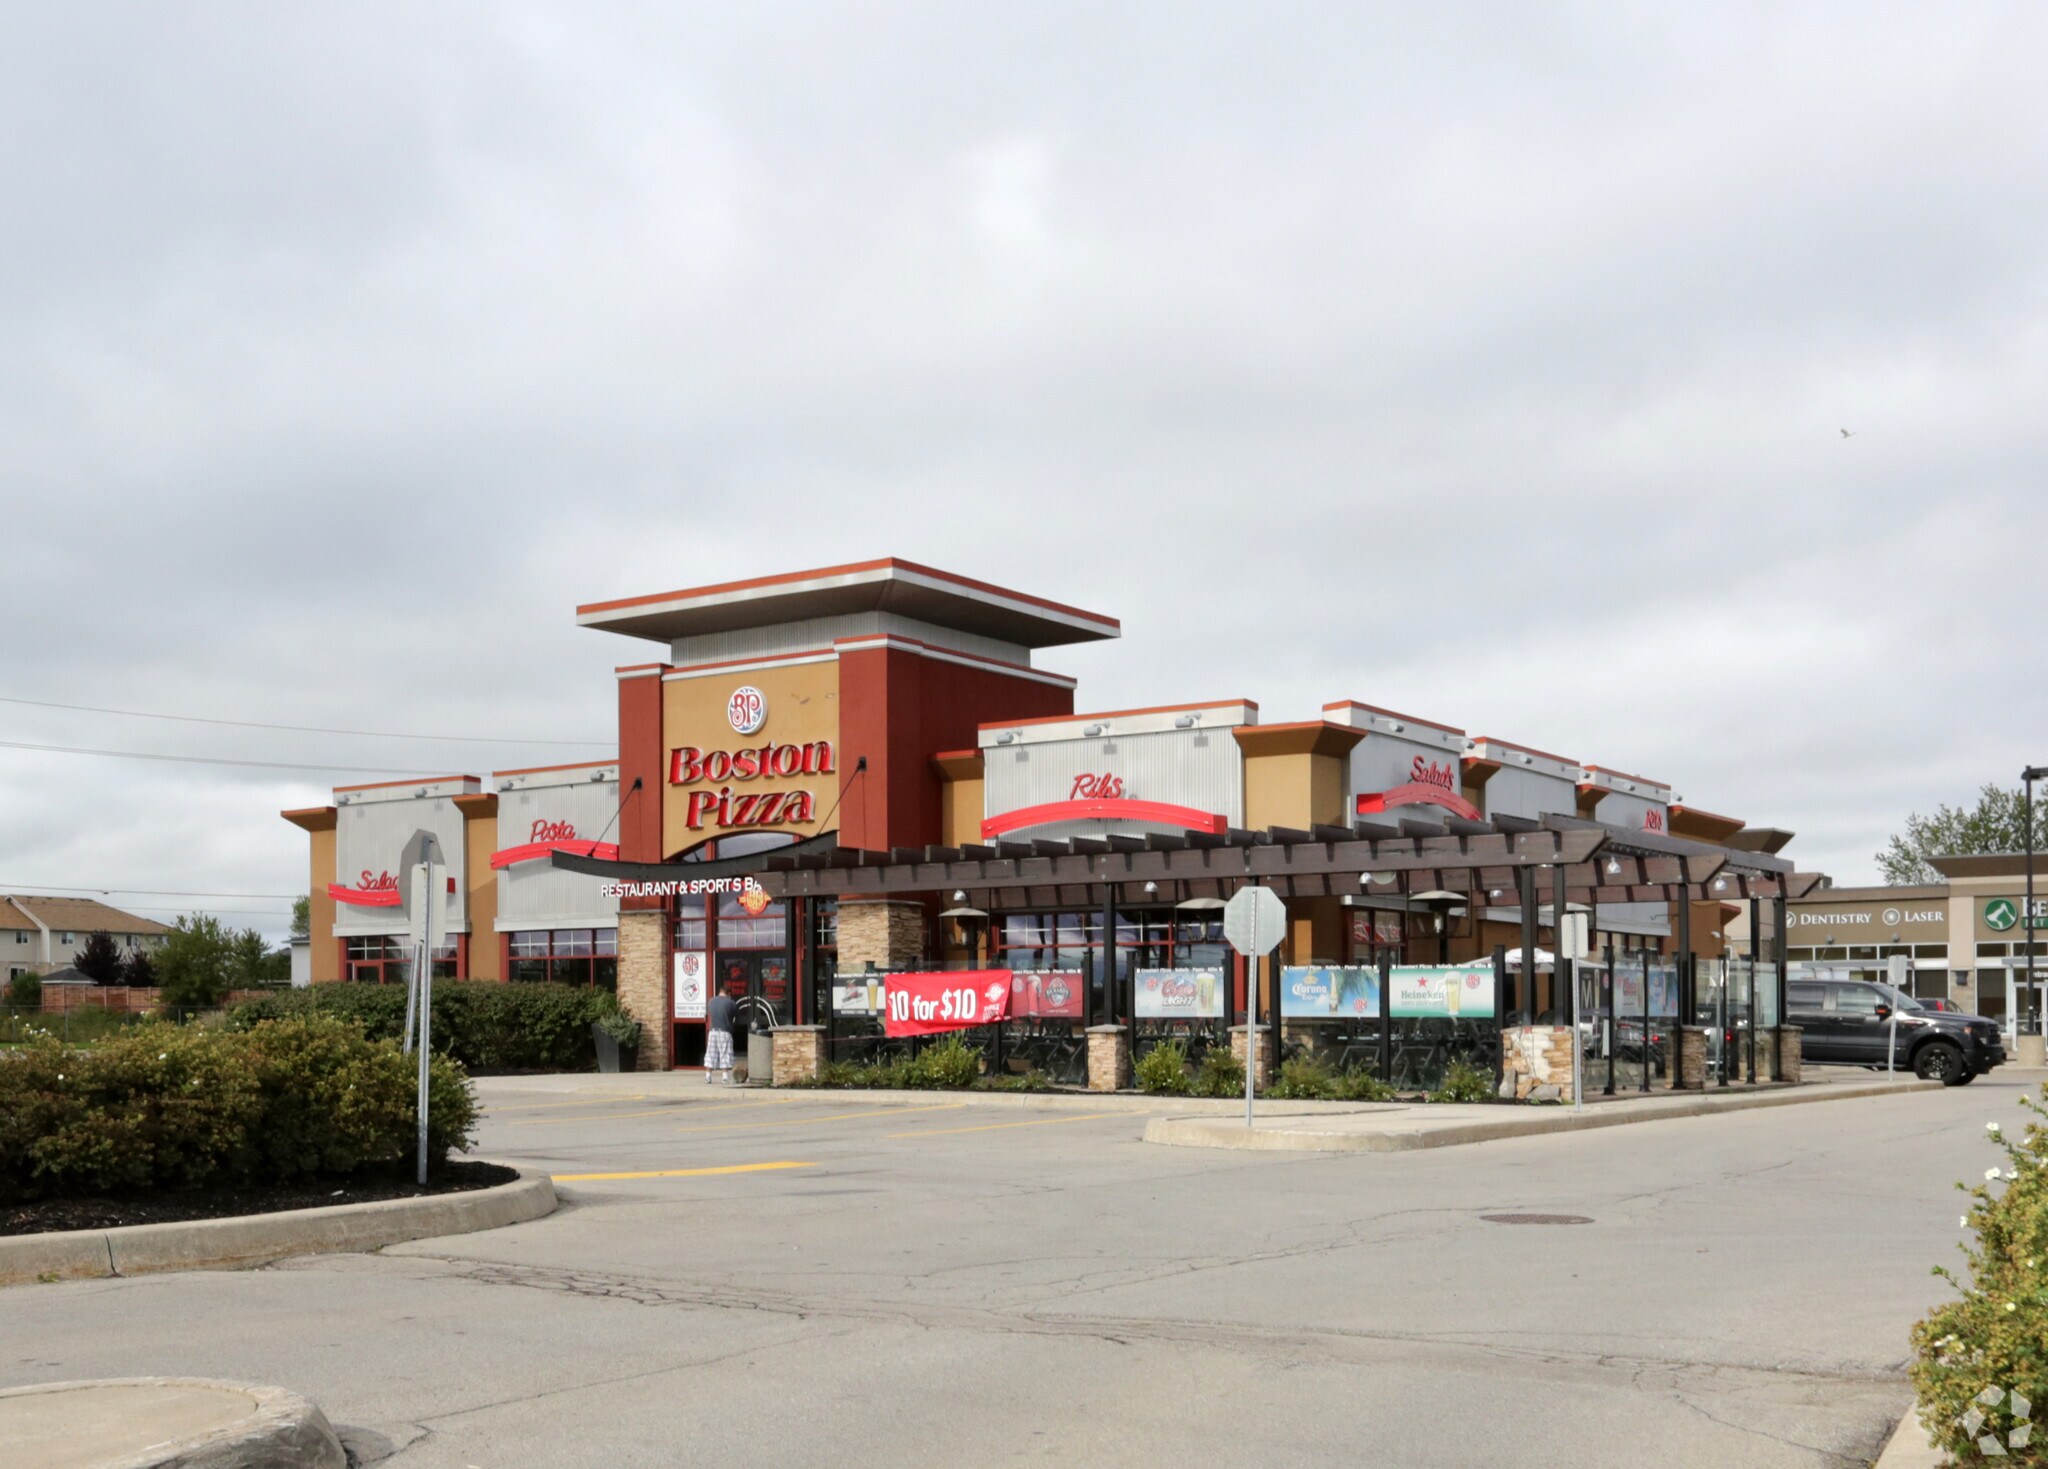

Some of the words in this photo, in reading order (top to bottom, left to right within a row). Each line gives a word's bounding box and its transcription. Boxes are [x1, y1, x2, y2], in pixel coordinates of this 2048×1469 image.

[730, 691, 762, 729] BP
[668, 739, 835, 786] Boston
[1410, 755, 1454, 791] Salads
[1070, 773, 1123, 800] Ribs
[685, 787, 815, 828] Pizza
[530, 819, 576, 843] Pasta
[601, 881, 678, 898] RESTAURANT
[678, 880, 688, 895] &
[1800, 912, 1872, 925] DENTISTRY
[1904, 911, 1944, 923] LASER
[1162, 996, 1196, 1007] LIGHT
[1292, 983, 1328, 996] Corona
[1401, 990, 1444, 999] Heineken
[888, 990, 909, 1021] 10
[912, 995, 939, 1021] for
[940, 988, 976, 1021] $10
